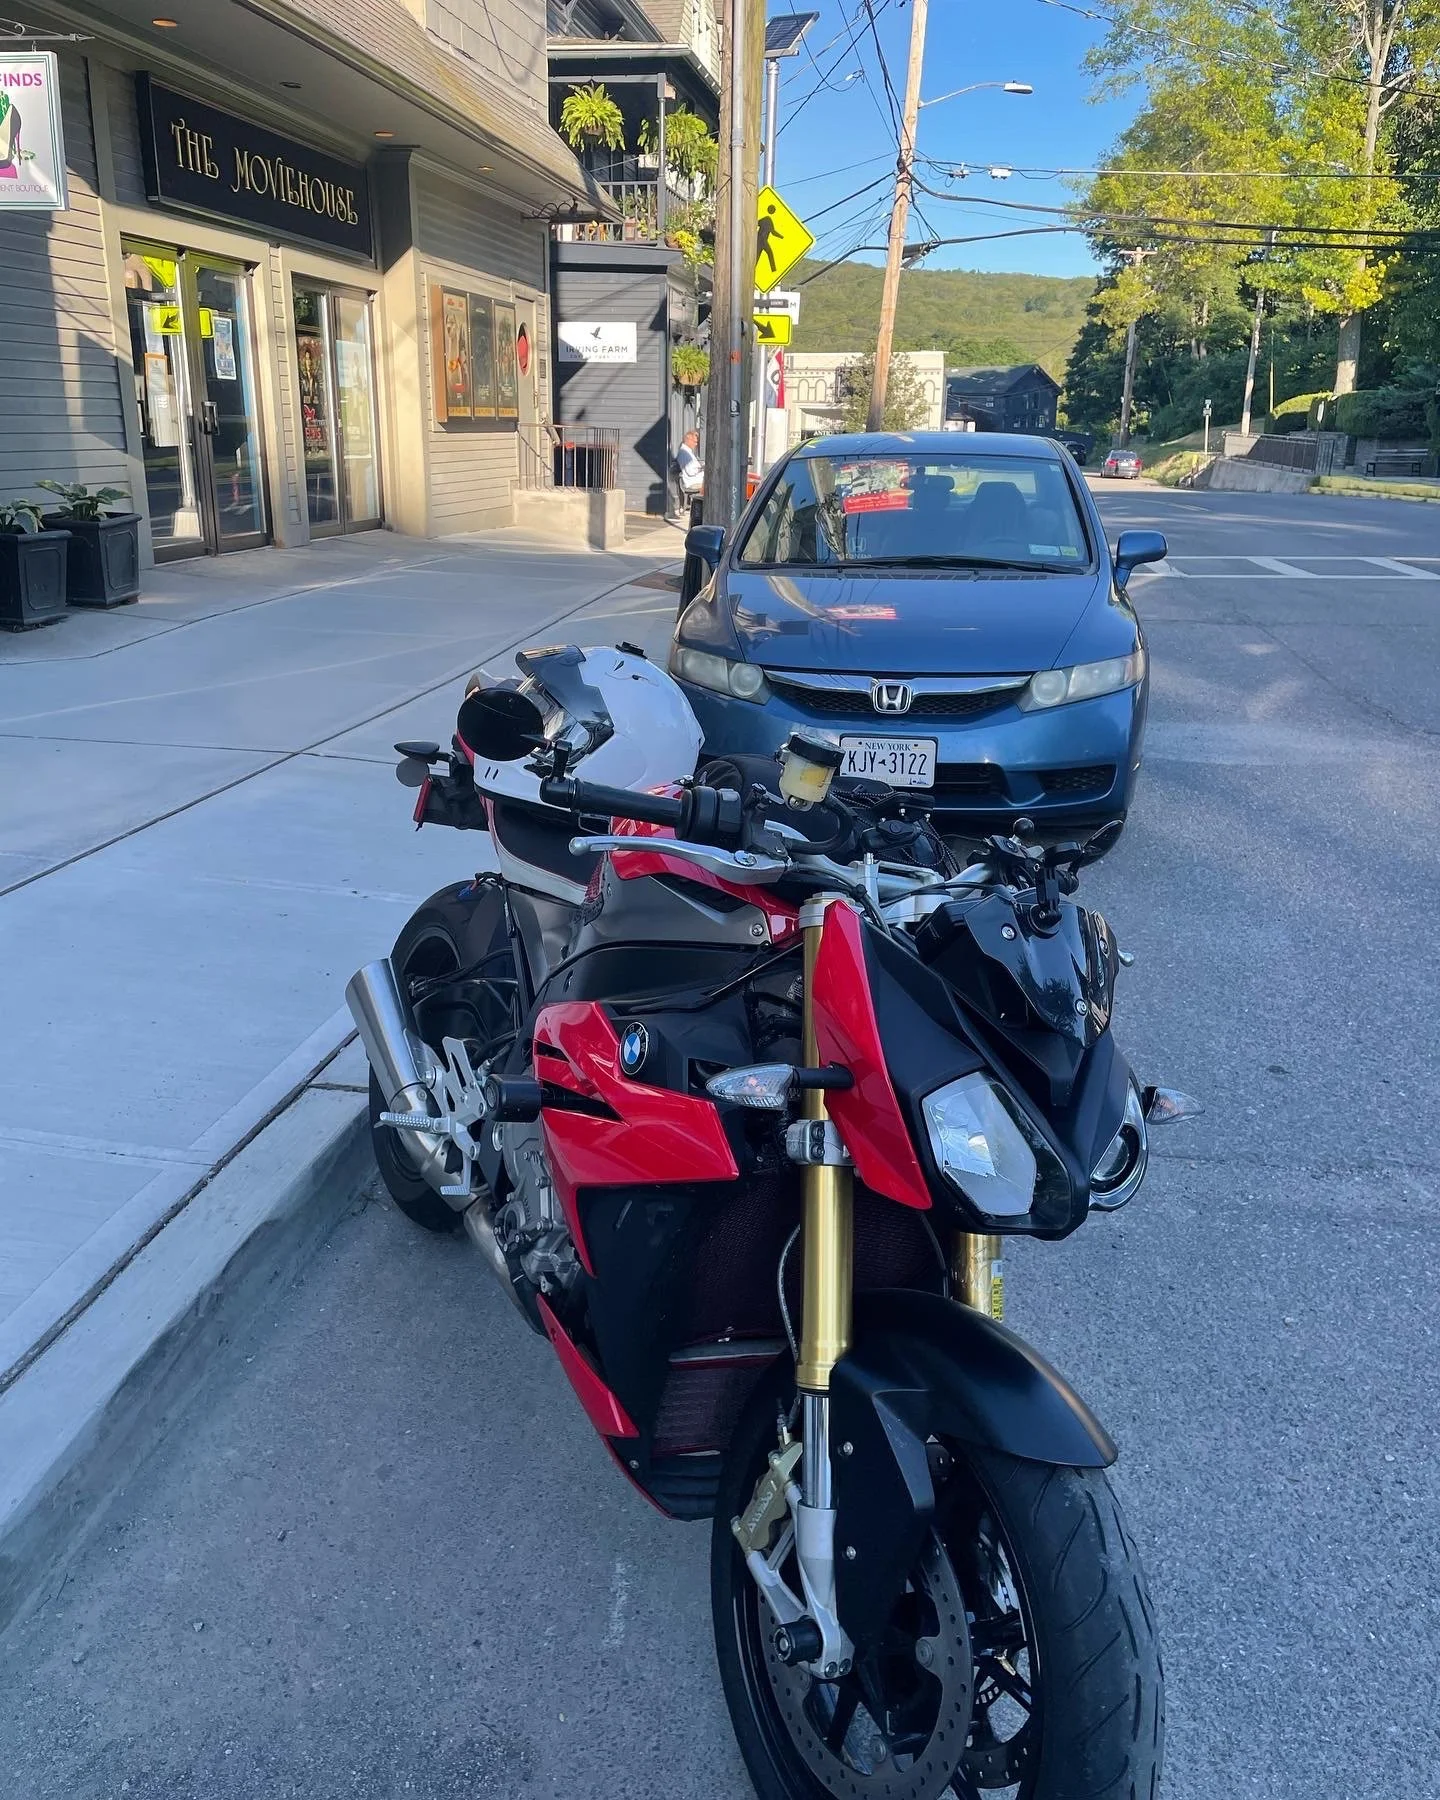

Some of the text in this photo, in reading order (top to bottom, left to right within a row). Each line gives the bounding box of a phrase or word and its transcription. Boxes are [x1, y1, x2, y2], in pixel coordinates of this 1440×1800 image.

[0, 73, 42, 87] INDS
[171, 118, 358, 225] THE MOVIEHOUSE
[566, 345, 628, 353] IRVING FARM
[864, 742, 911, 751] NEW YORK
[848, 750, 927, 776] KJY 3122
